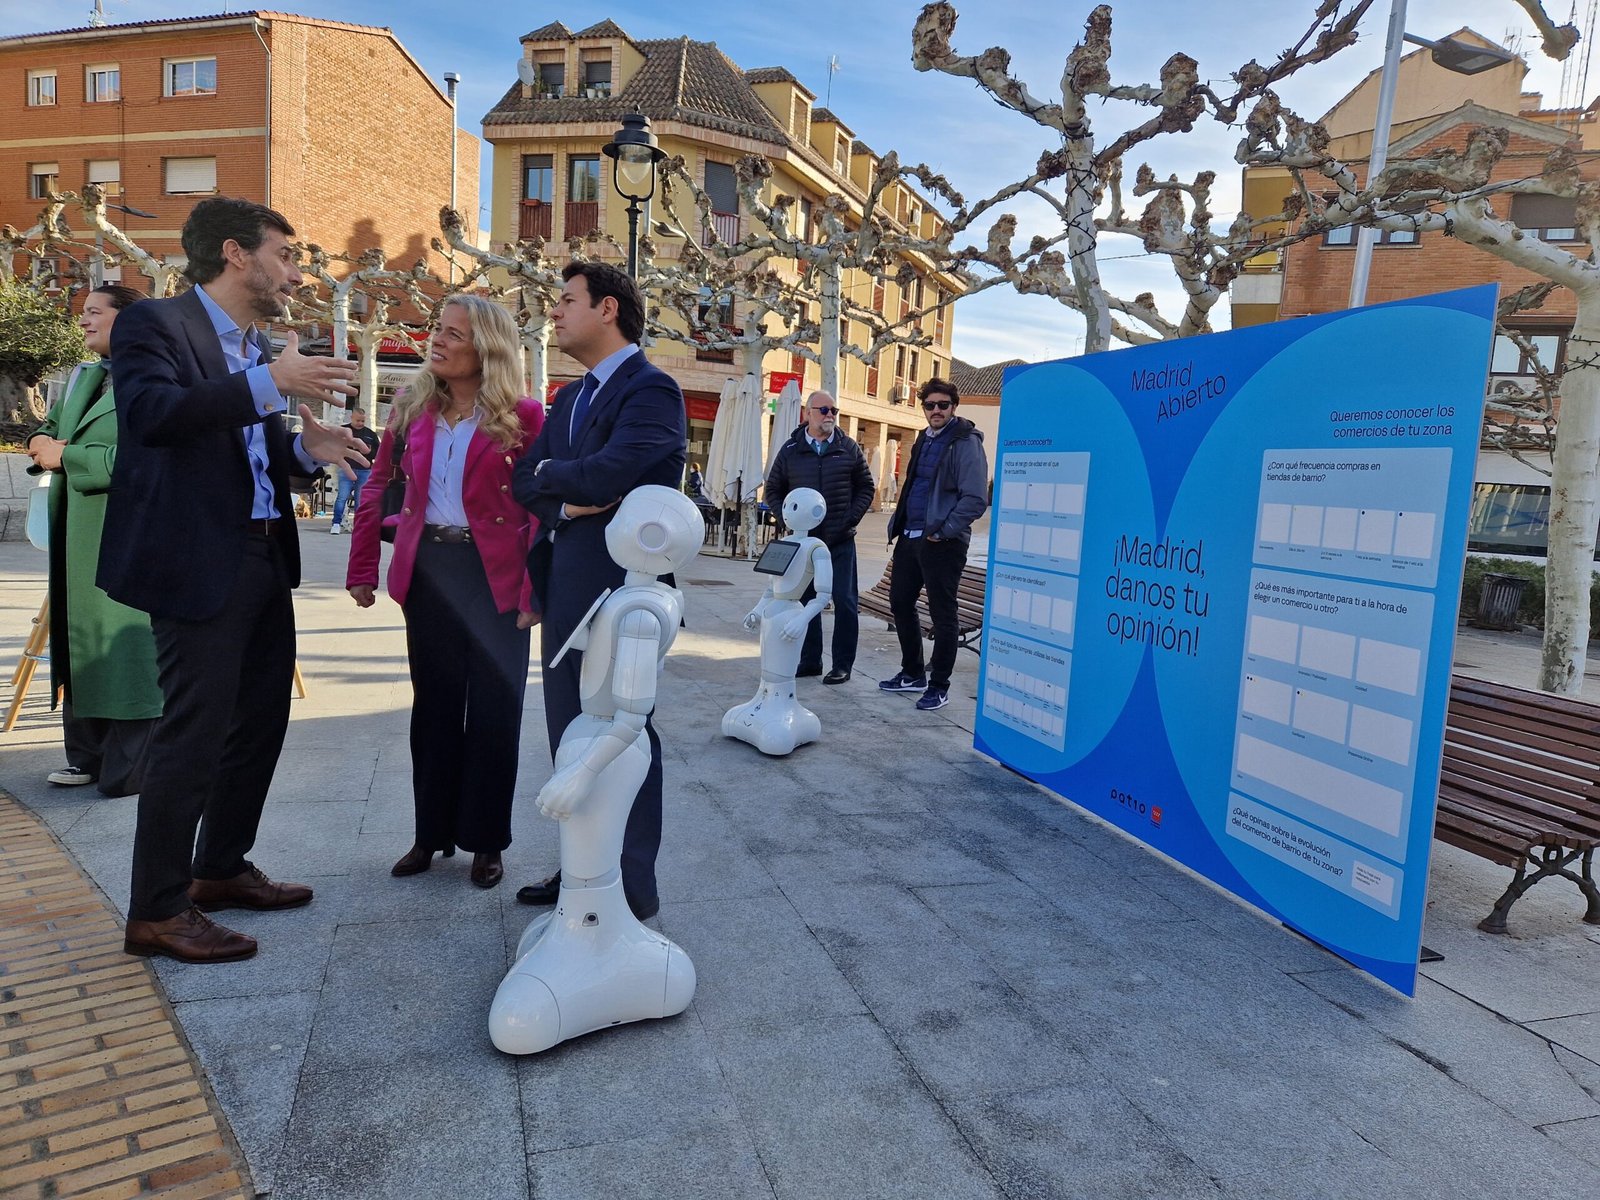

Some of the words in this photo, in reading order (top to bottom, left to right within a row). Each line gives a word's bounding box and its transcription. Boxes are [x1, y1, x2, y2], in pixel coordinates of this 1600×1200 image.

[1131, 359, 1193, 392] Madrid
[1157, 375, 1226, 423] Abierto
[1329, 410, 1383, 422] Queremos
[1385, 407, 1434, 419] conocer
[1436, 404, 1455, 417] los
[1333, 425, 1388, 438] comercios
[1390, 423, 1405, 436] de
[1408, 424, 1420, 436] tu
[1422, 424, 1452, 436] zona
[1267, 473, 1291, 481] tiendas
[1291, 473, 1300, 481] de
[1302, 473, 1326, 482] barrio?
[1268, 461, 1284, 471] ¿Con
[1286, 461, 1298, 471] qué
[1299, 461, 1335, 470] frecuencia
[1336, 463, 1369, 472] compras
[1370, 463, 1381, 471] en
[1113, 534, 1205, 579] ¡Madrid,
[1106, 568, 1176, 610] danos
[1183, 582, 1209, 617] tu
[1253, 592, 1271, 603] elegir
[1281, 597, 1312, 610] comercio
[1320, 605, 1339, 614] otro?
[1254, 581, 1271, 590] ¿Qué
[1272, 584, 1280, 592] es
[1281, 585, 1295, 595] más
[1296, 589, 1335, 602] importante
[1336, 595, 1353, 604] para
[1355, 596, 1360, 606] ti
[1361, 599, 1367, 607] a
[1368, 598, 1375, 608] la
[1376, 600, 1395, 612] hora
[1396, 604, 1407, 614] de
[1107, 611, 1200, 657] opinión!
[1231, 816, 1241, 827] del
[1242, 821, 1271, 842] comercio
[1271, 835, 1281, 847] de
[1281, 840, 1301, 856] barrio
[1302, 851, 1312, 861] de
[1312, 856, 1321, 866] tu
[1321, 860, 1344, 877] zona?
[1232, 807, 1249, 819] ¿Qué
[1249, 813, 1270, 830] opinas
[1270, 824, 1290, 839] sobre
[1290, 832, 1297, 842] la
[1297, 837, 1331, 858] evolución
